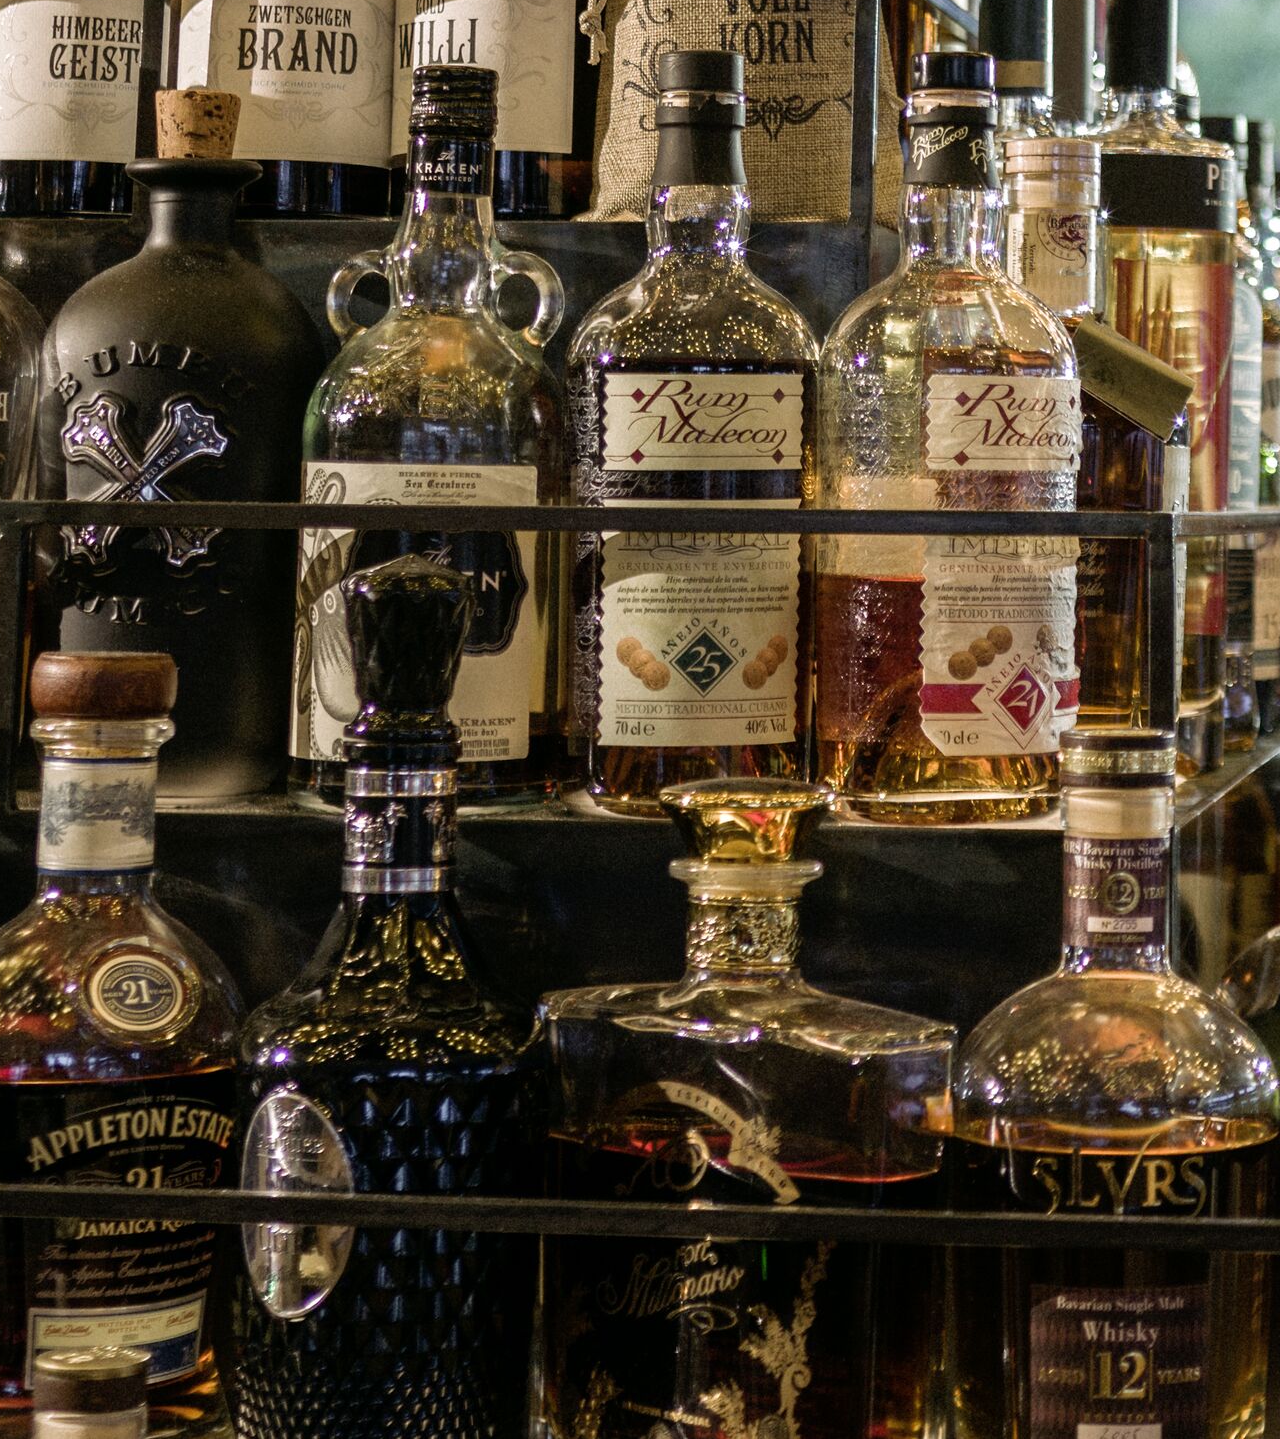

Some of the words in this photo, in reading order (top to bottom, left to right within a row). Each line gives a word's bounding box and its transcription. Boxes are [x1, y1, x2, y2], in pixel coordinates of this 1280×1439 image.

[52, 15, 141, 44] HIMBEER
[247, 5, 352, 29] ZWETSCHGEN
[237, 28, 357, 75] BRAND
[399, 18, 479, 69] WILLI
[720, 18, 817, 65] KORN
[49, 43, 140, 84] GEIST
[416, 162, 480, 175] KRAKEN
[630, 379, 750, 418] Rum
[954, 384, 1057, 422] Rum
[627, 408, 787, 454] Malecon
[937, 608, 989, 619] METODO
[661, 617, 701, 660] AÑEJO
[709, 618, 748, 659] AÑOS
[684, 646, 724, 684] 25
[984, 653, 1022, 698] AÑEJO
[616, 704, 663, 715] METODO
[664, 703, 746, 715] TRADICIONAL
[748, 701, 788, 713] CUBANO
[1006, 679, 1039, 719] 21
[459, 717, 512, 728] KRAKEN
[616, 720, 628, 735] 70
[631, 721, 641, 735] cl
[745, 719, 769, 735] 40%
[1083, 843, 1135, 857] Bavarian
[1074, 857, 1113, 874] Whisky
[1109, 883, 1132, 904] 12
[121, 979, 153, 1005] 21
[26, 1107, 169, 1172] APPLETON
[169, 1105, 236, 1150] ESTATE
[75, 1219, 155, 1239] JAMAICA
[1056, 1295, 1113, 1311] Bavarian
[1117, 1297, 1154, 1315] Single
[1158, 1295, 1185, 1311] Malt
[1082, 1320, 1160, 1348] Whisky
[1093, 1351, 1148, 1400] 12
[1157, 1366, 1201, 1384] YEARS
